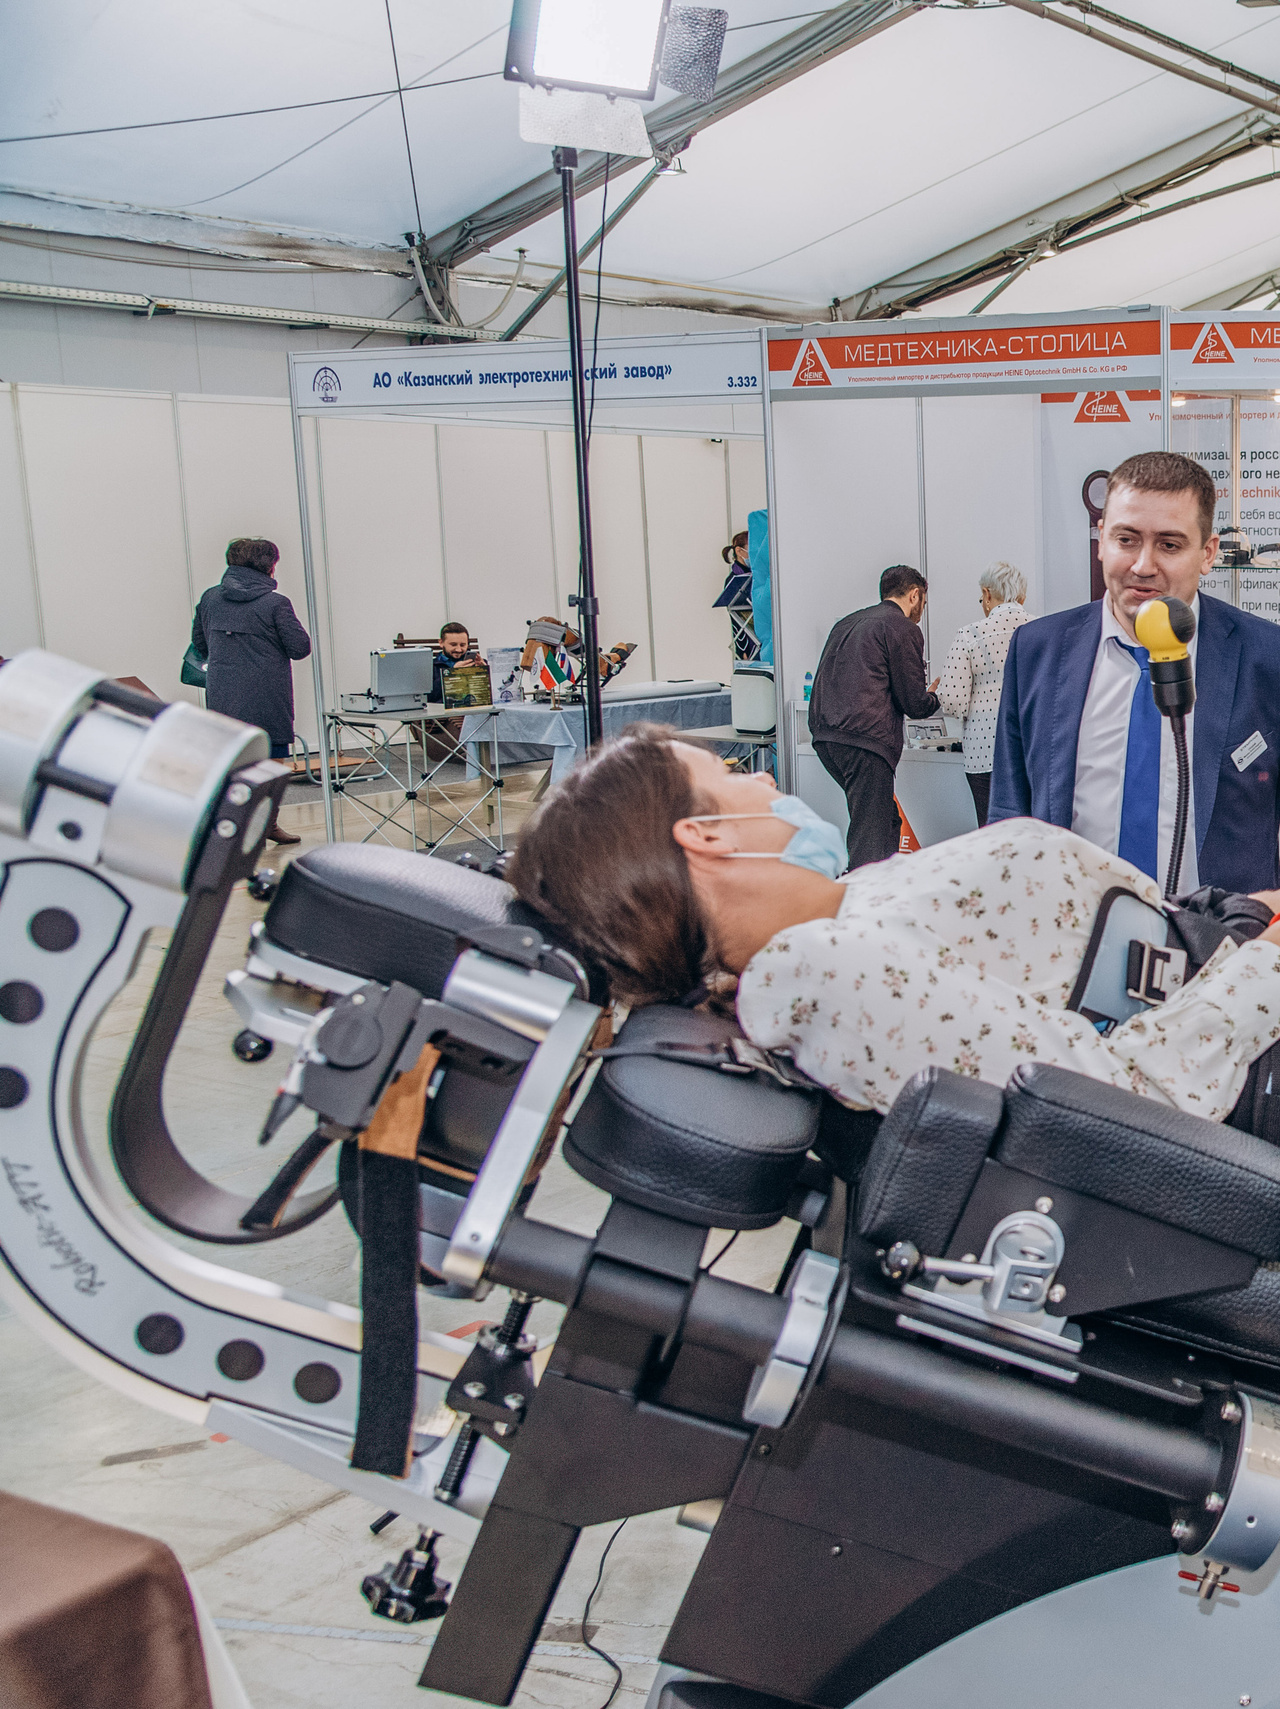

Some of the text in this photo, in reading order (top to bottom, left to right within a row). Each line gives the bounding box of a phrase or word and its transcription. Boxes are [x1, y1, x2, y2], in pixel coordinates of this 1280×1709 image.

[844, 331, 1128, 365] МЕДТЕХНИКА-СТОЛИЦА
[1204, 350, 1226, 358] HEINE
[373, 362, 672, 388] АО «Казанский электротехничский завод»
[804, 371, 824, 380] HEINE
[848, 375, 896, 383] Уполномоченный
[897, 374, 924, 382] импортер
[930, 372, 971, 381] дистрибьютор
[972, 371, 1004, 379] продукции
[1024, 368, 1061, 376] Optotechnik
[1062, 366, 1081, 374] GmbH
[1082, 366, 1087, 374] &
[1116, 364, 1128, 372] РФ
[727, 376, 758, 388] 3.332
[1091, 404, 1118, 414] HEINE
[1240, 508, 1265, 520] себя
[1242, 602, 1262, 612] при
